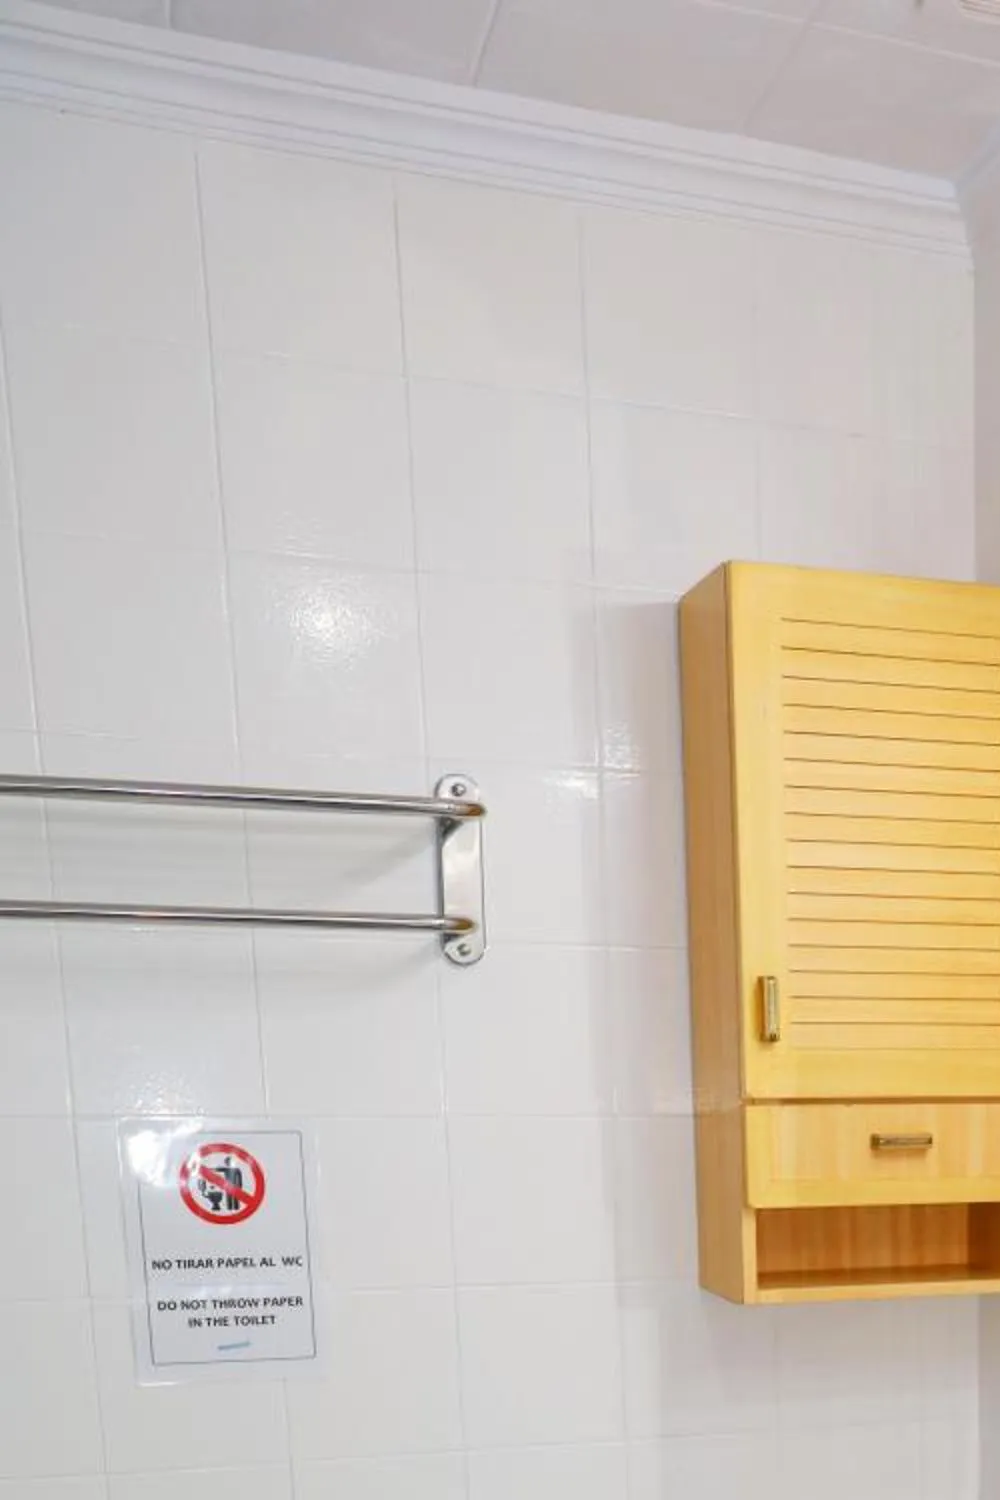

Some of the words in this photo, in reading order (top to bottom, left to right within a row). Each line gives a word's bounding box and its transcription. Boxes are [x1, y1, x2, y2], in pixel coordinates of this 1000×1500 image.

[152, 1259, 172, 1270] NO
[175, 1257, 214, 1269] TIRAR
[217, 1256, 256, 1268] PAPEL
[260, 1256, 276, 1267] AL
[281, 1256, 303, 1267] WC
[157, 1300, 177, 1311] DO
[180, 1299, 207, 1311] NOT
[212, 1297, 260, 1309] THROW
[263, 1296, 303, 1307] PAPER
[188, 1318, 203, 1328] IN
[206, 1317, 230, 1327] THE
[234, 1315, 276, 1326] TOILET
